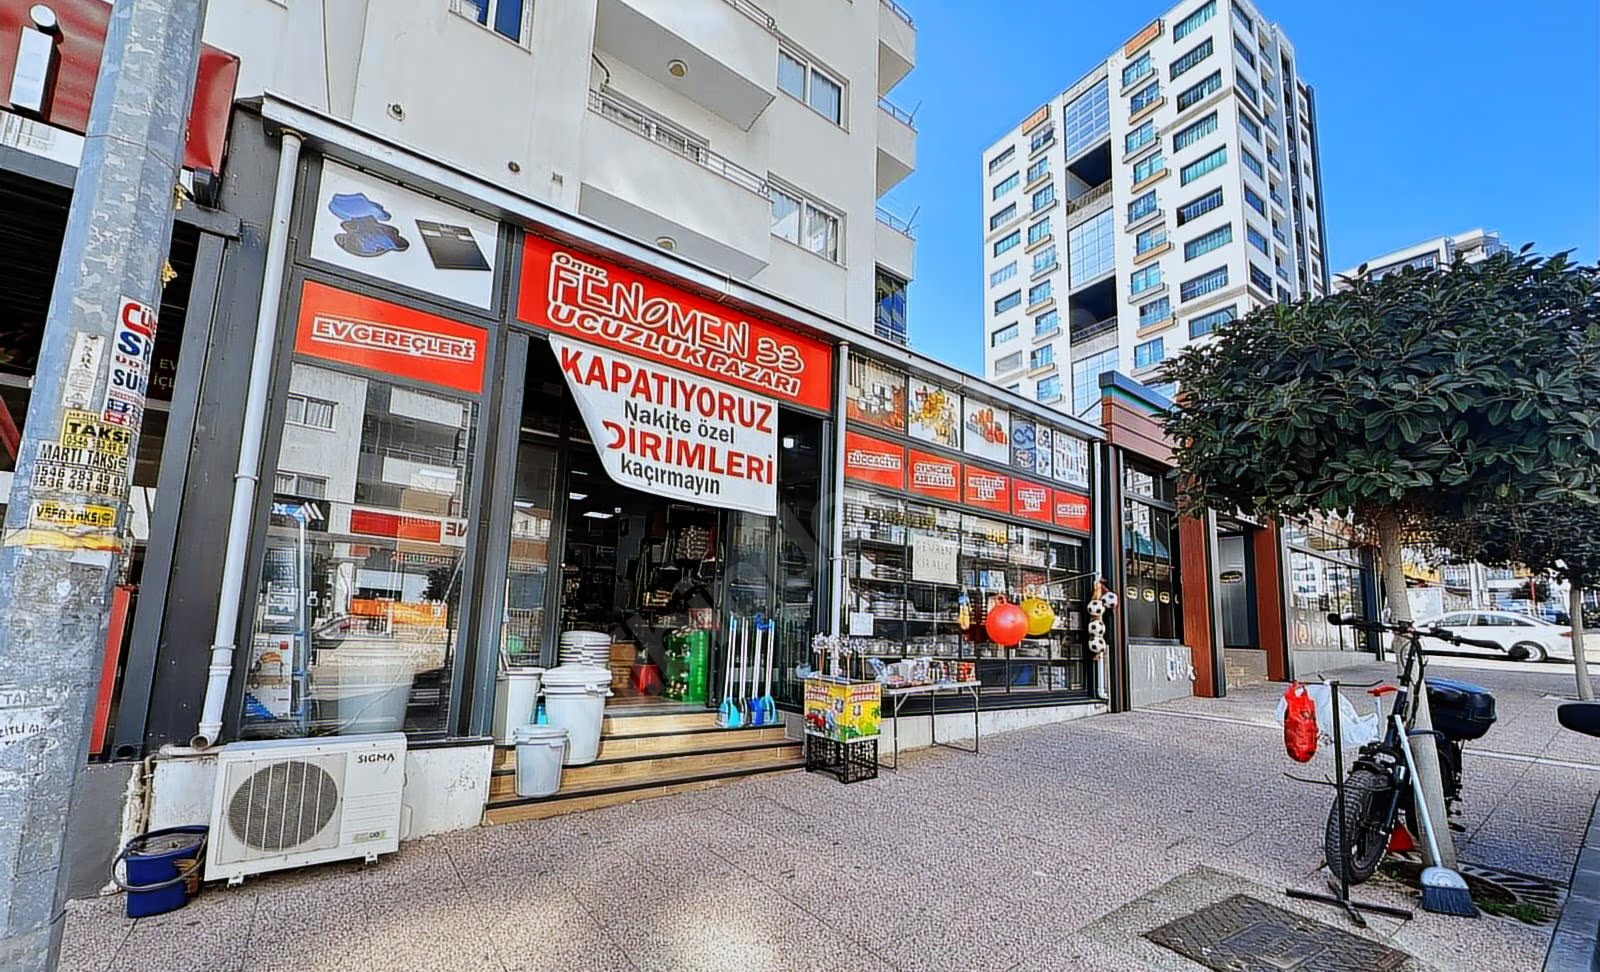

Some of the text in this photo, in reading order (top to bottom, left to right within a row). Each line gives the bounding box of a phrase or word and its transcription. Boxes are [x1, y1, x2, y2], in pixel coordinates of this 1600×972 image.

[553, 252, 607, 277] Onur
[548, 262, 805, 374] FENOMEN 33
[547, 302, 801, 397] UCUZLUK PAZARI
[561, 346, 773, 434] KAPATIYORUZ
[624, 400, 735, 445] Nakite özel
[621, 453, 721, 496] kaçırmayın
[357, 753, 395, 764] SIGMA
